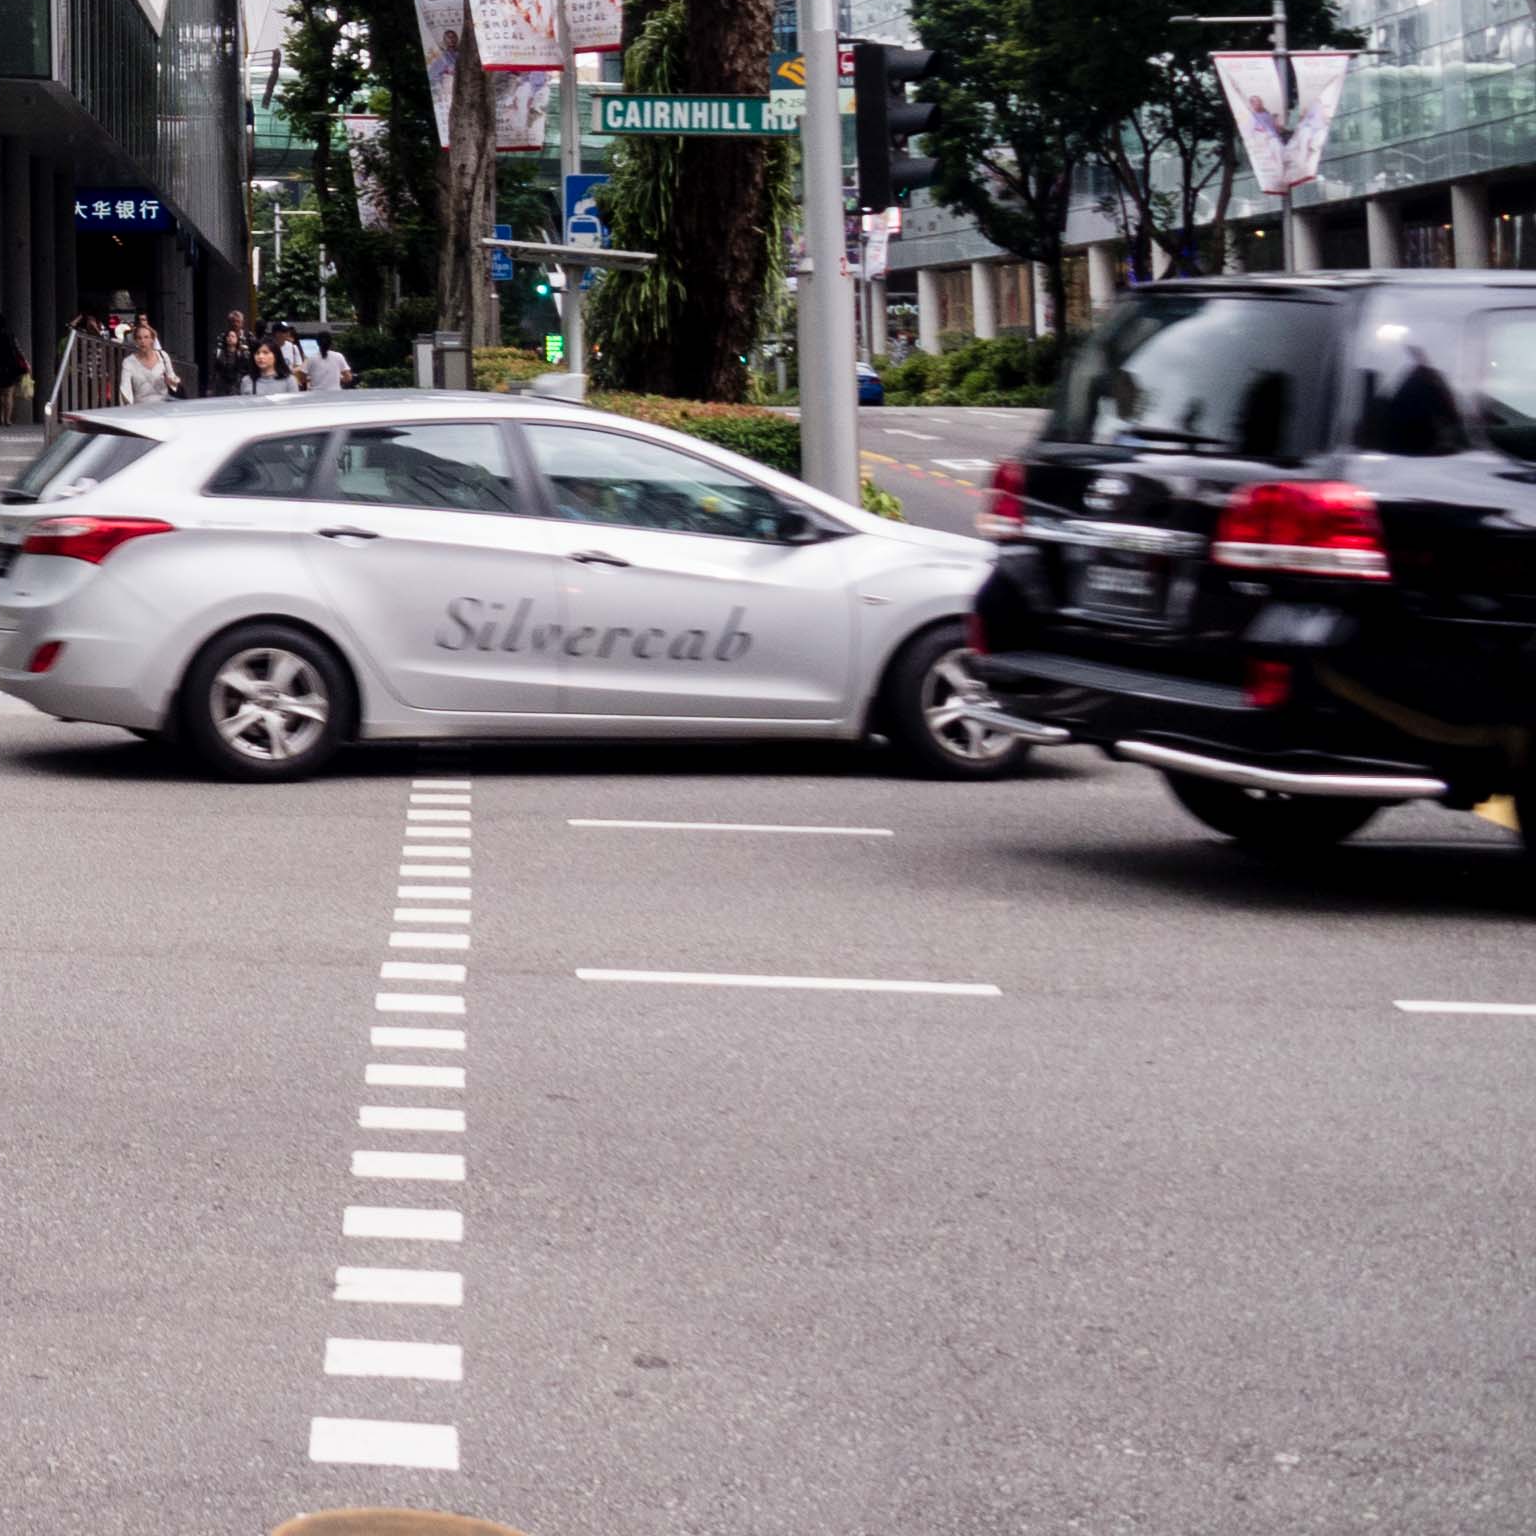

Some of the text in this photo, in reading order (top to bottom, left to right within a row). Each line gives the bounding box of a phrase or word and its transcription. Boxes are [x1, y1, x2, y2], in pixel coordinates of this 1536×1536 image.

[606, 100, 752, 131] CAIRNHILL
[74, 199, 159, 220] 大华银行
[434, 596, 753, 662] Silvercab
